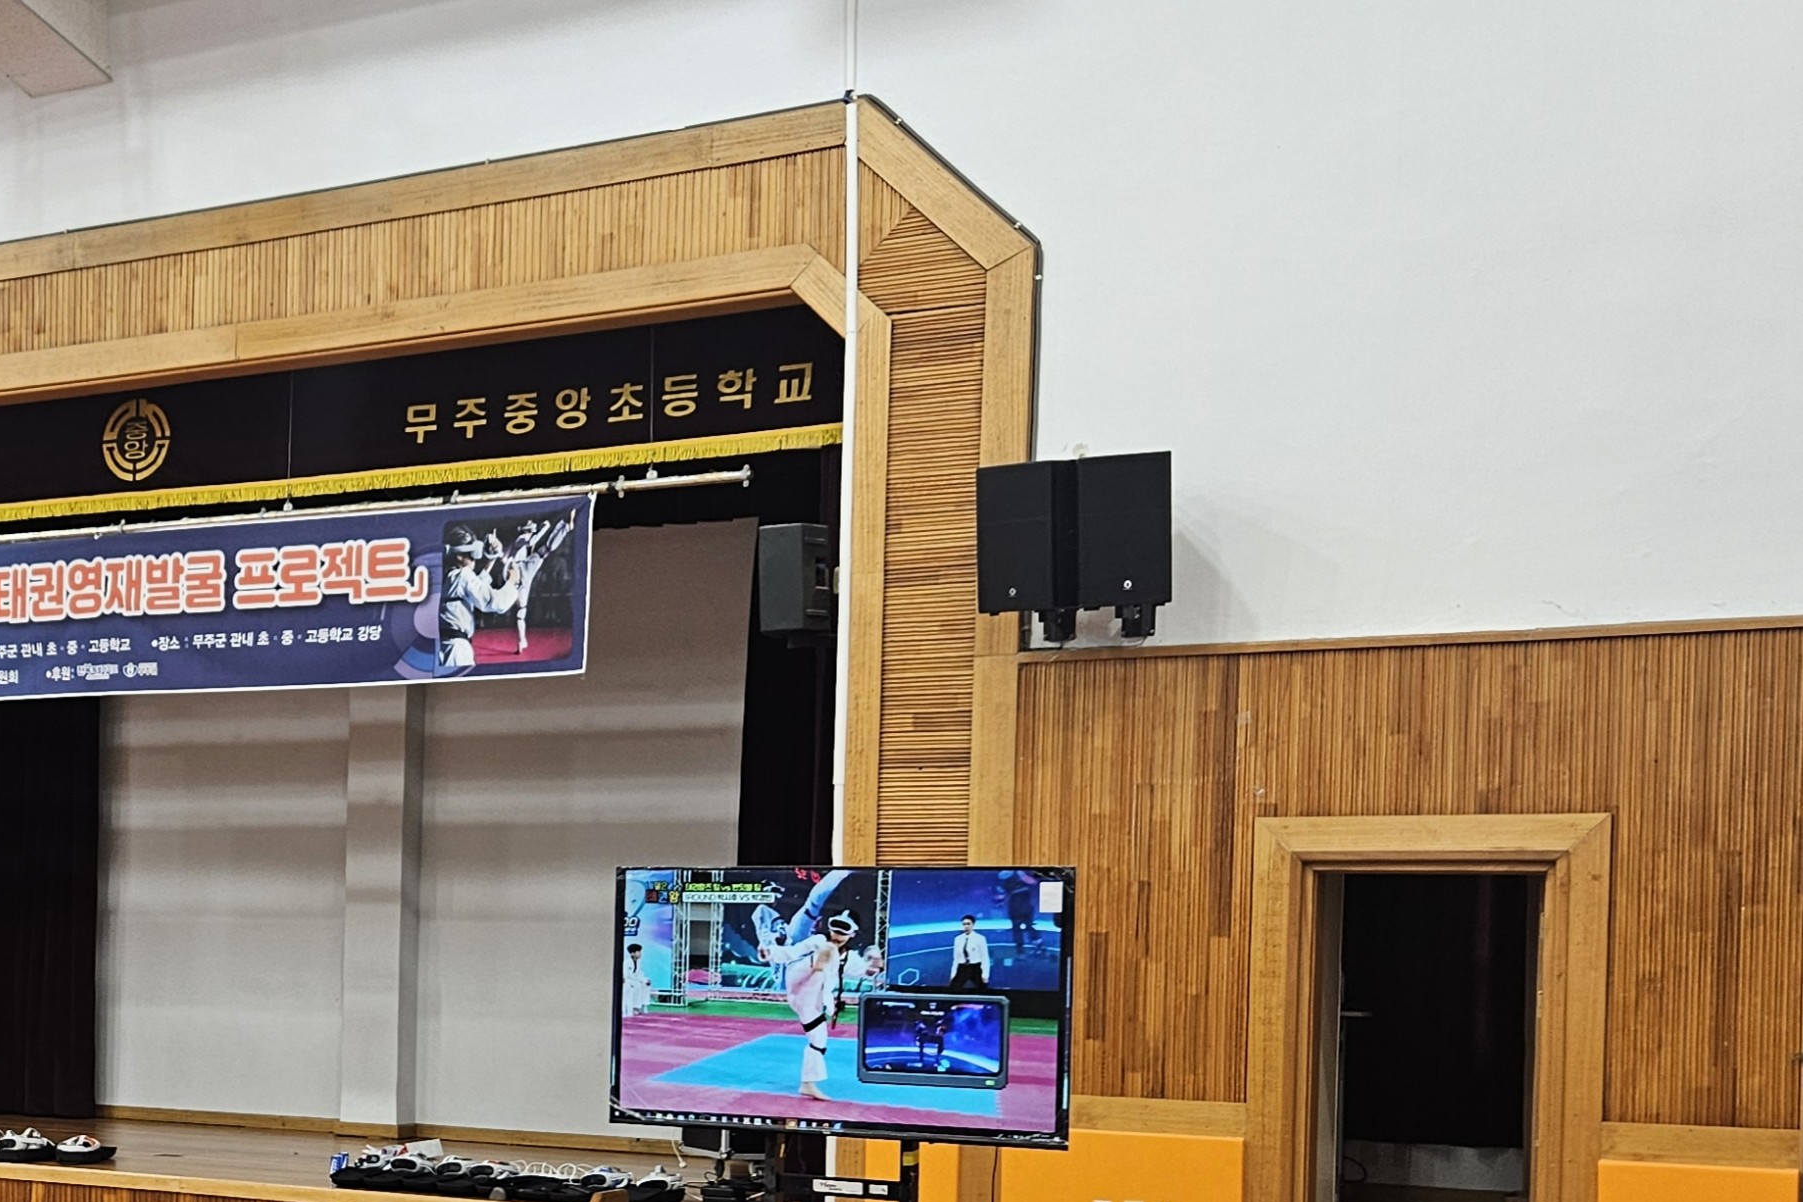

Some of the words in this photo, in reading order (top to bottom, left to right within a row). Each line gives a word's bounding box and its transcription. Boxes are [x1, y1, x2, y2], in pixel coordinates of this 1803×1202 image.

[404, 362, 814, 444] 무주중앙초등학교
[233, 537, 428, 609] 프로젝트」
[20, 642, 43, 657] 관내
[88, 637, 131, 652] 고등학교
[158, 636, 180, 651] 장소
[192, 633, 227, 649] 무주군
[229, 631, 254, 647] 관내
[305, 627, 353, 643] 고등학교
[357, 625, 382, 641] 강당
